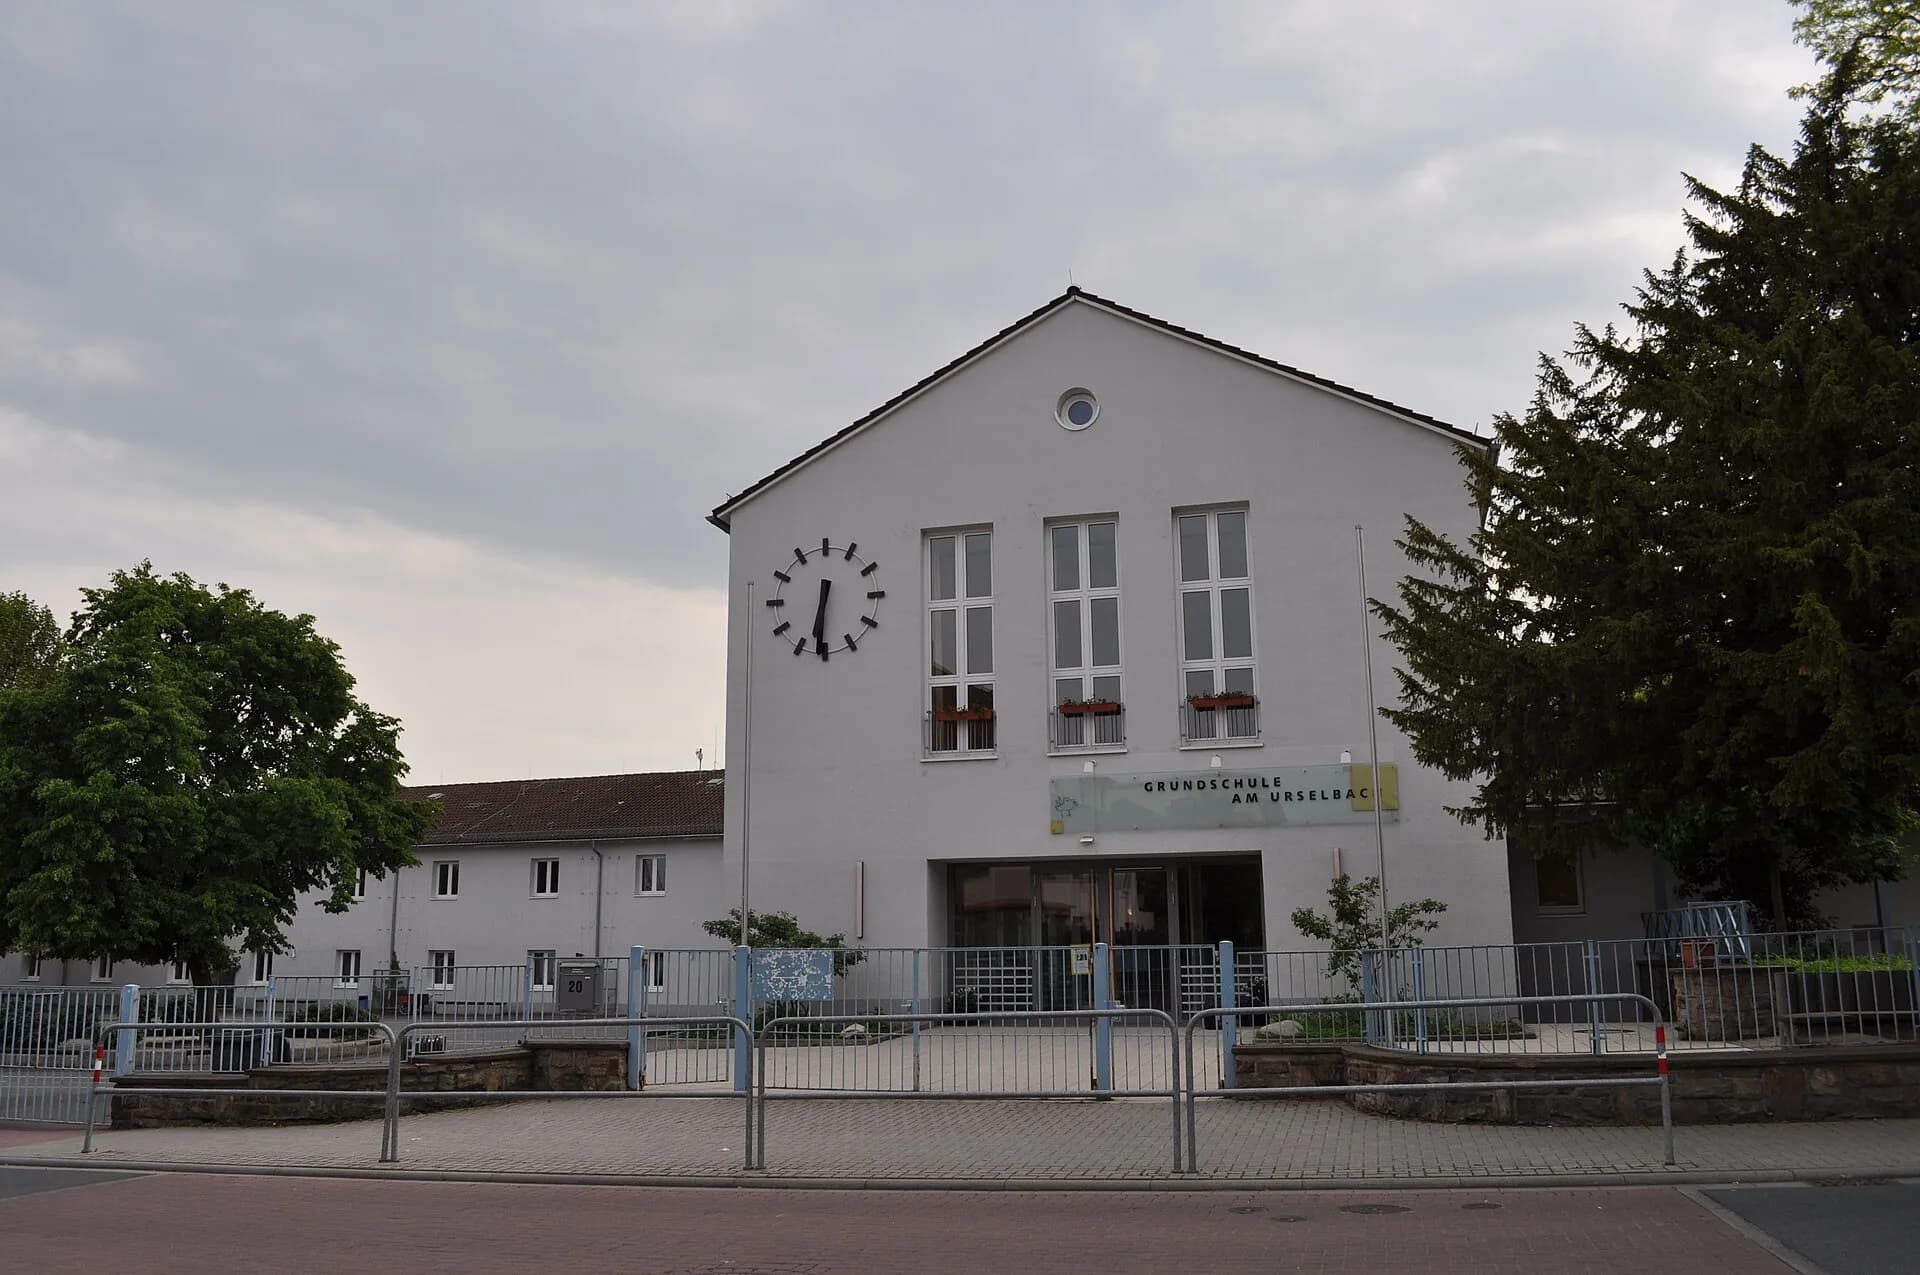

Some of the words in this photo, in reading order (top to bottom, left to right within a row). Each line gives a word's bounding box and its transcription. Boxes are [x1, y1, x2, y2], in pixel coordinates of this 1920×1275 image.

[1144, 776, 1281, 792] GRUNDSCHULE
[1231, 793, 1259, 804] AM
[1270, 787, 1382, 802] URSELBAC
[568, 980, 583, 993] 20
